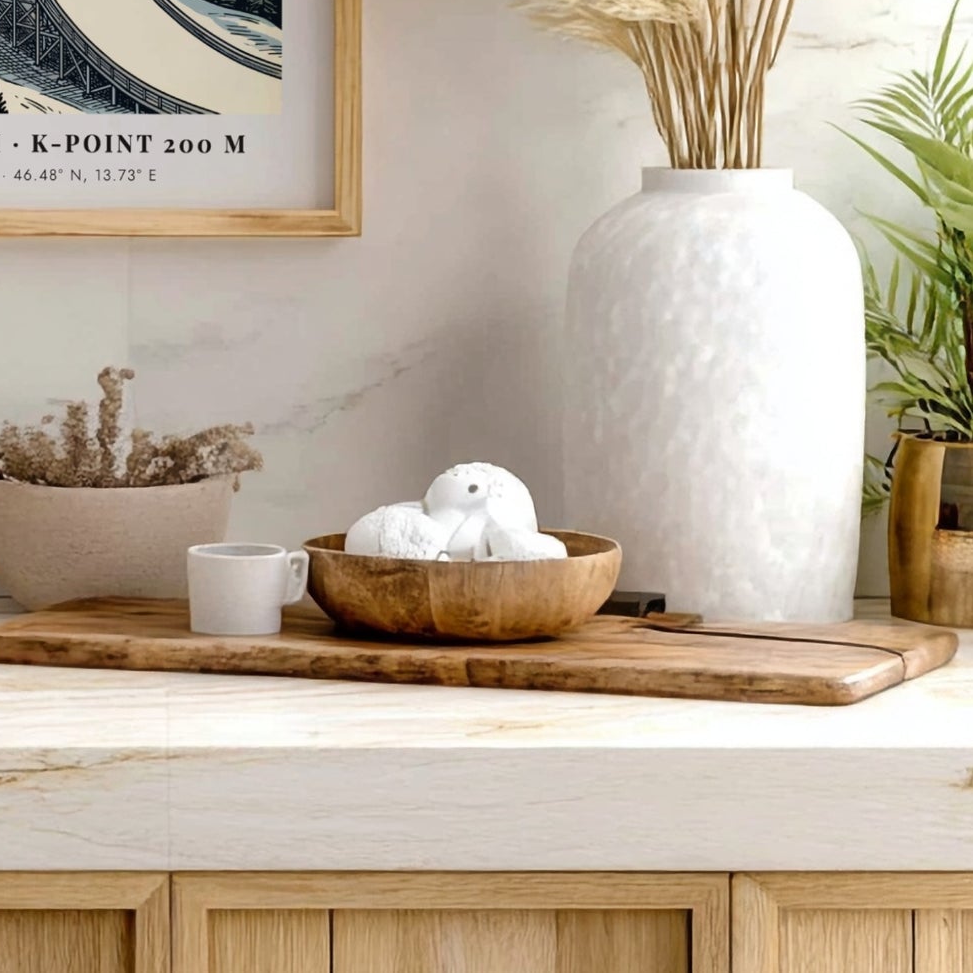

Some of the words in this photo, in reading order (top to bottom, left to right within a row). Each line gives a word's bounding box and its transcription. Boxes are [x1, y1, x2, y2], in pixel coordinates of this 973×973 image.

[31, 133, 153, 154] K-POINT
[163, 138, 212, 154] 200
[224, 134, 246, 154] M
[70, 169, 88, 184] N,
[148, 168, 157, 182] E
